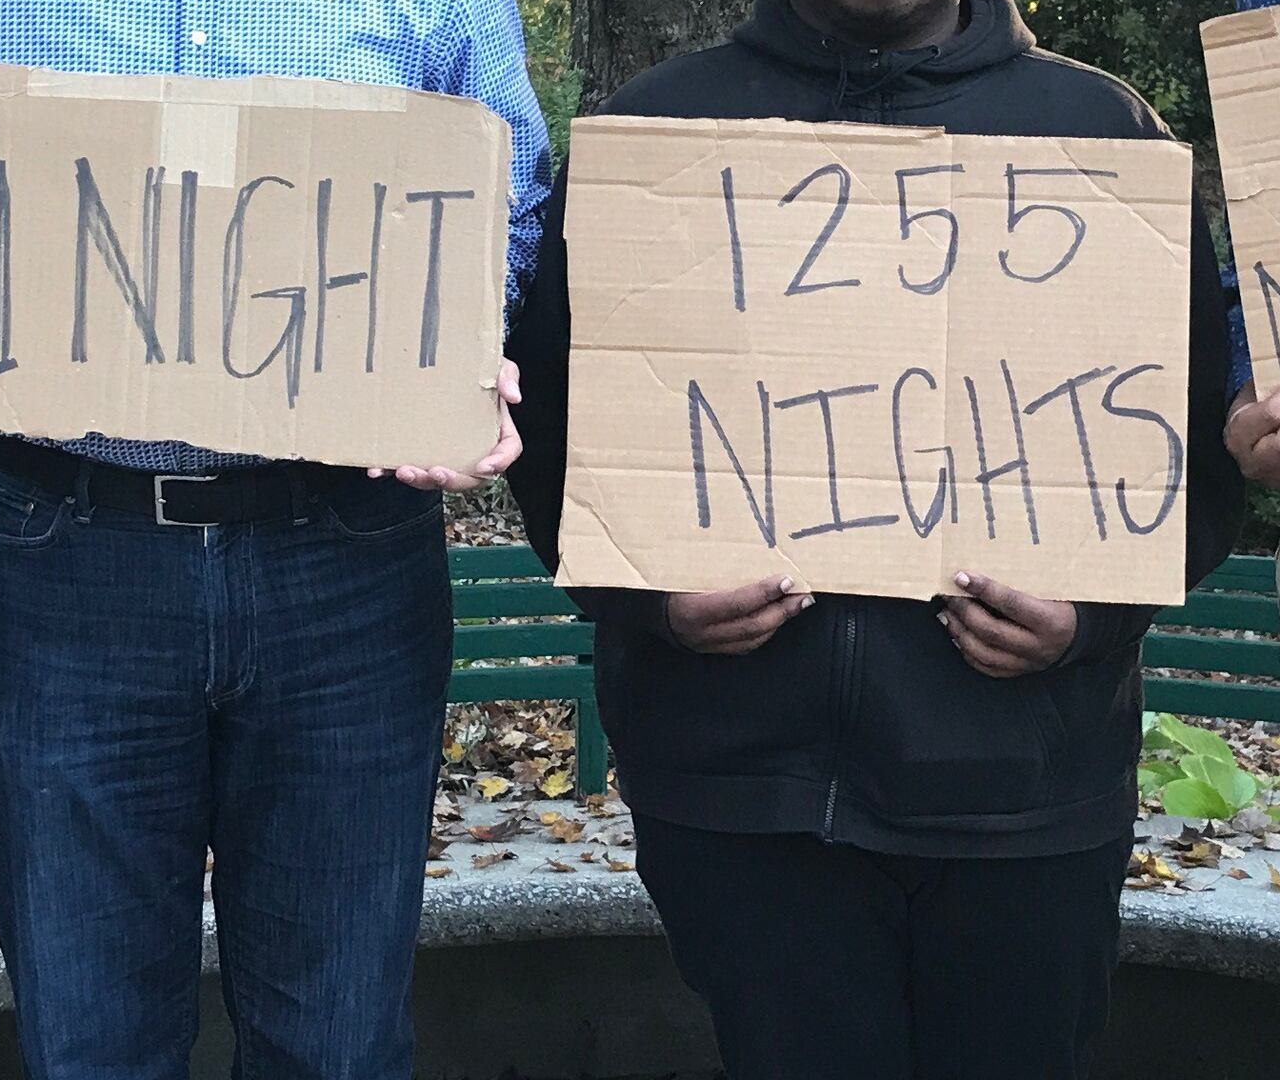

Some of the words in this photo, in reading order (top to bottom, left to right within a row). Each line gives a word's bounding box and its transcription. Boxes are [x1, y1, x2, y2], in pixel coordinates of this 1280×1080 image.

[72, 156, 475, 409] NIGHT
[721, 163, 1119, 313] 1255
[688, 358, 1183, 548] NIGHTS
